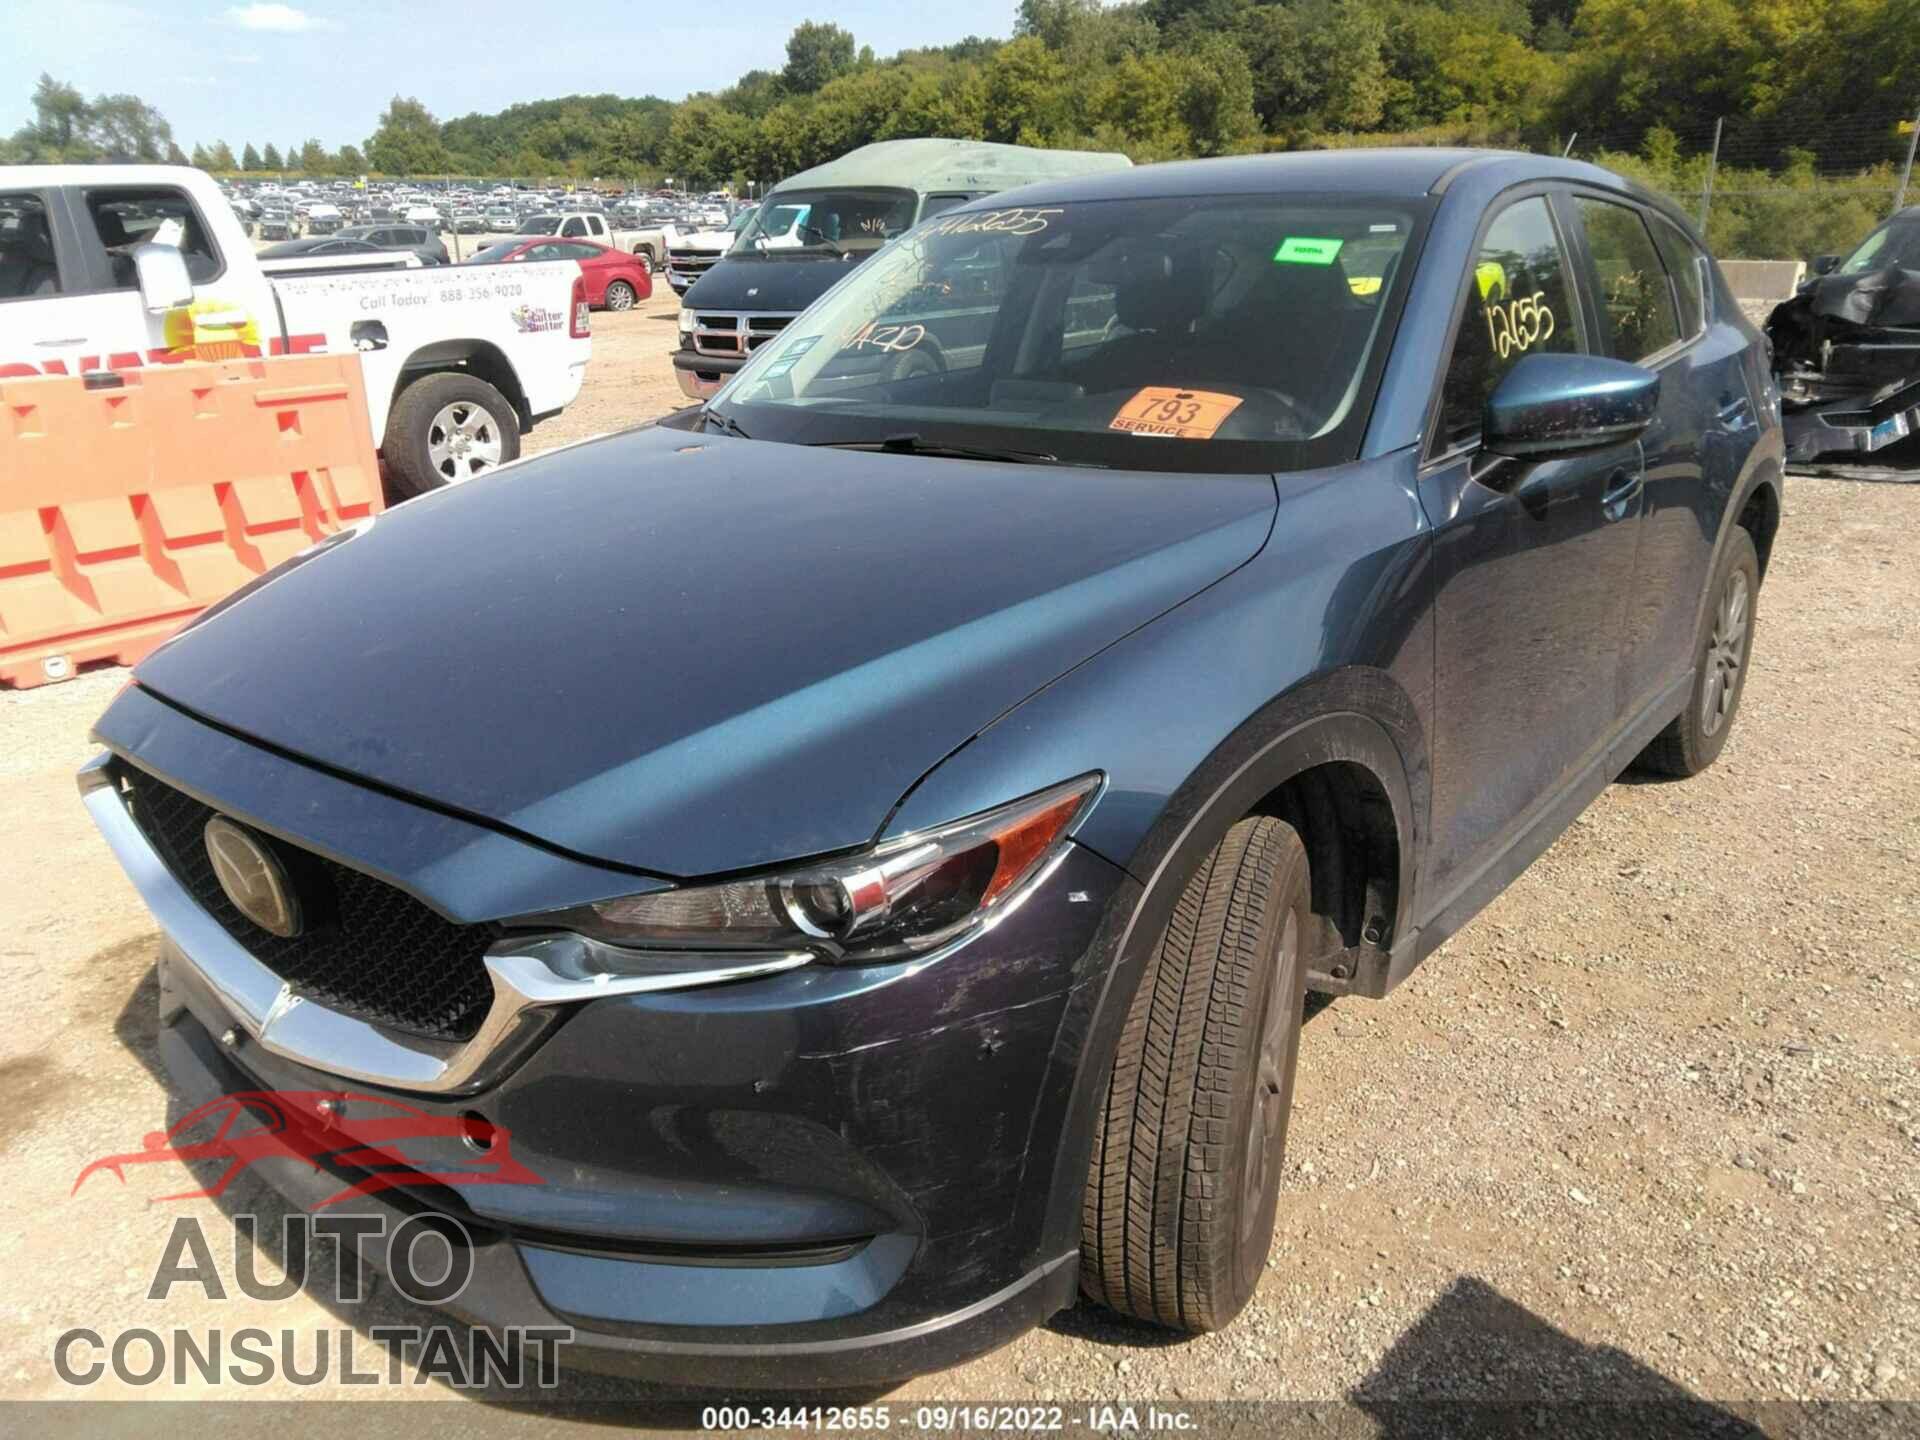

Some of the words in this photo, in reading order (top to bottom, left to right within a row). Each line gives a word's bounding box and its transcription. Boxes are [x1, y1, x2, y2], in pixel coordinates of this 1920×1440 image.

[359, 296, 386, 310] Call
[391, 293, 428, 307] Today
[1486, 291, 1554, 358] 12655
[1139, 398, 1202, 424] 793
[1112, 418, 1191, 437] SERVICE
